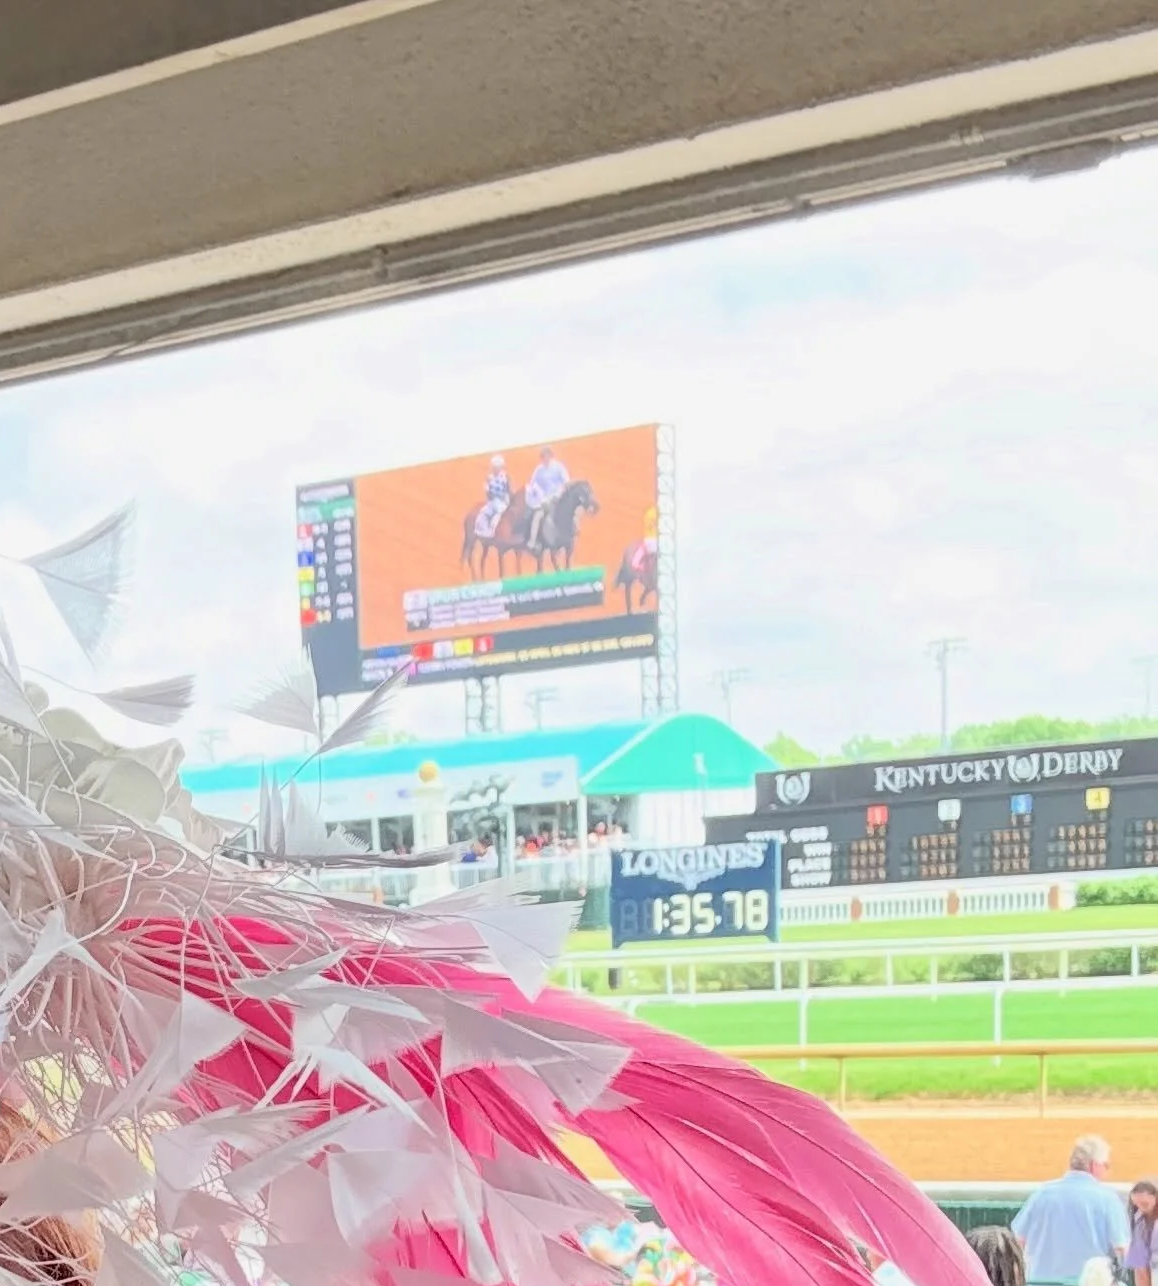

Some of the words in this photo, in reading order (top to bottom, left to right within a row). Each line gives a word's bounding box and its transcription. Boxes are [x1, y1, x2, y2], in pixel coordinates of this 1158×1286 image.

[874, 758, 1006, 793] KENTUCKY
[1042, 748, 1124, 778] DERBY
[621, 842, 768, 877] LONGINES
[653, 889, 769, 935] 1:35.78
